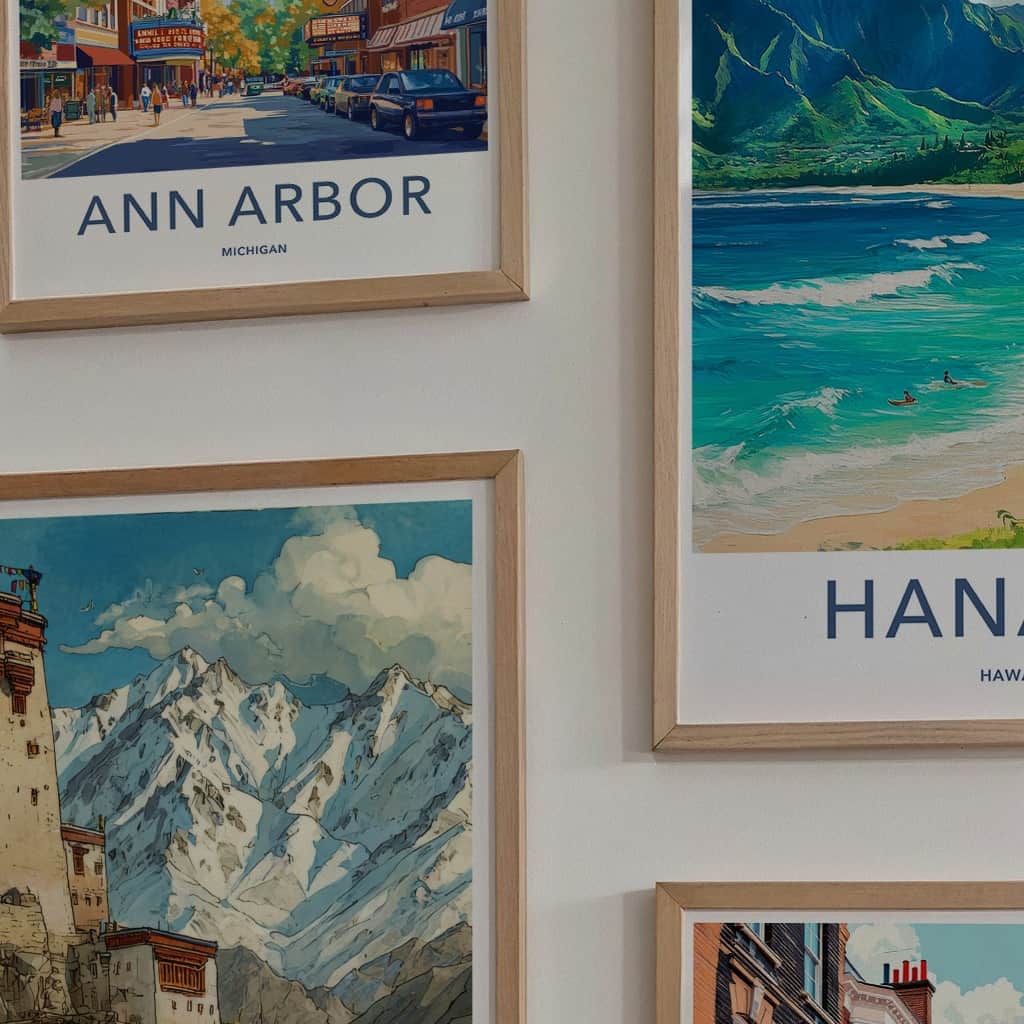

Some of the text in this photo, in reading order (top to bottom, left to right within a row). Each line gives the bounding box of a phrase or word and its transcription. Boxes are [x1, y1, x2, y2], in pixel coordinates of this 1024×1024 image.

[76, 175, 432, 236] ANN ARBOR
[221, 243, 288, 257] MICHIGAN
[827, 577, 1024, 639] HAN
[980, 668, 1024, 682] HAW
